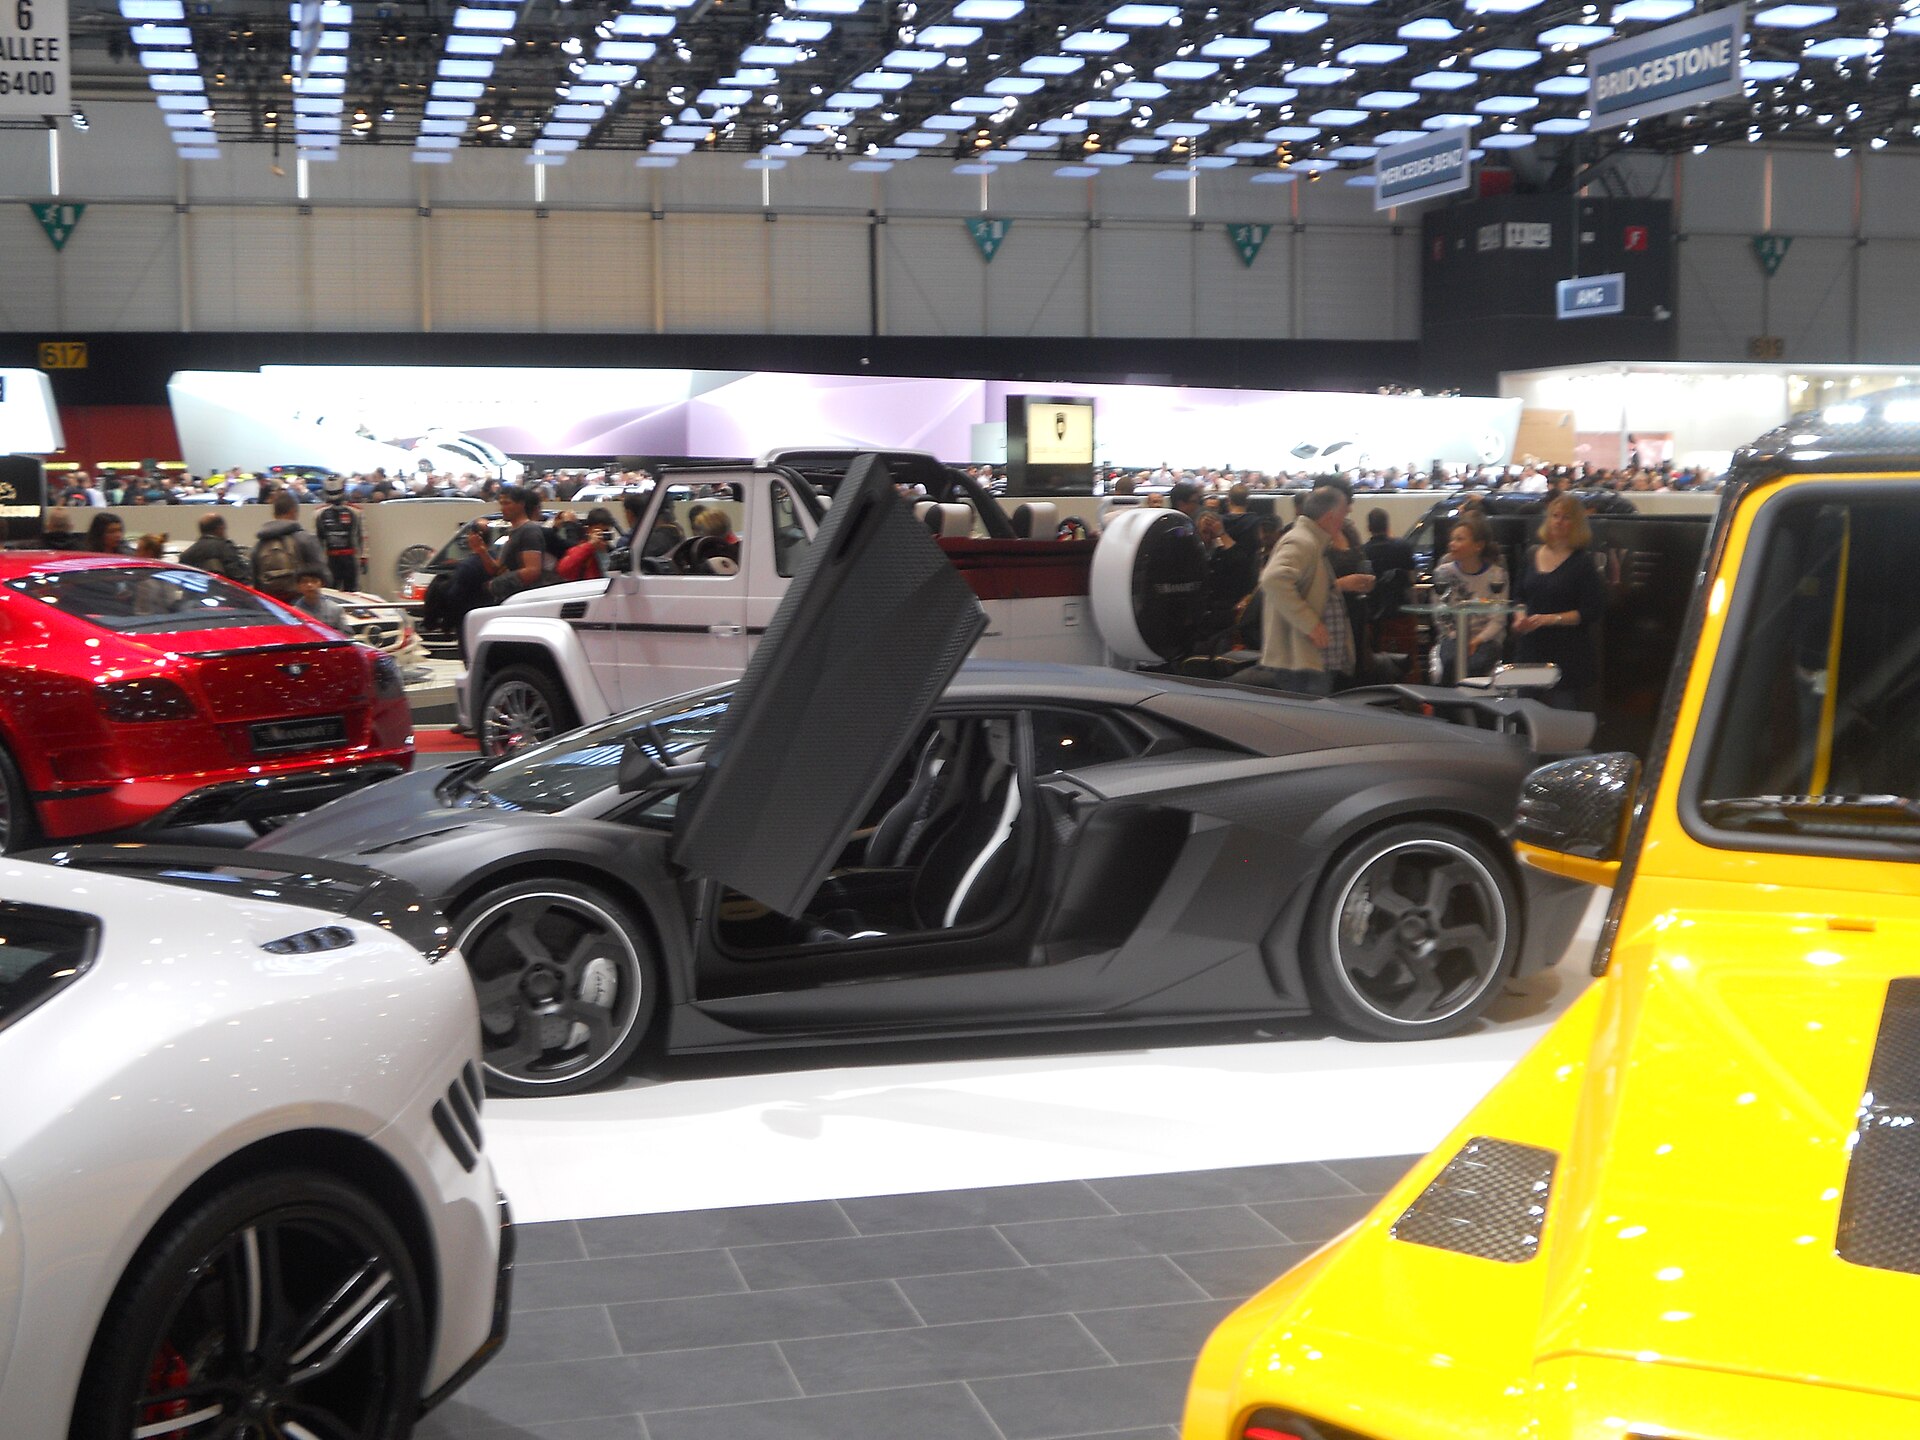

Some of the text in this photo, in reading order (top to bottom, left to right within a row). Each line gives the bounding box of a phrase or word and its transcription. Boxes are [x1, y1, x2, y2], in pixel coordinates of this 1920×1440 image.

[17, 0, 33, 31] 6
[1596, 38, 1731, 100] BRIDGESTONE
[0, 71, 55, 95] 6400
[1575, 287, 1605, 305] AMG
[43, 344, 84, 366] 617
